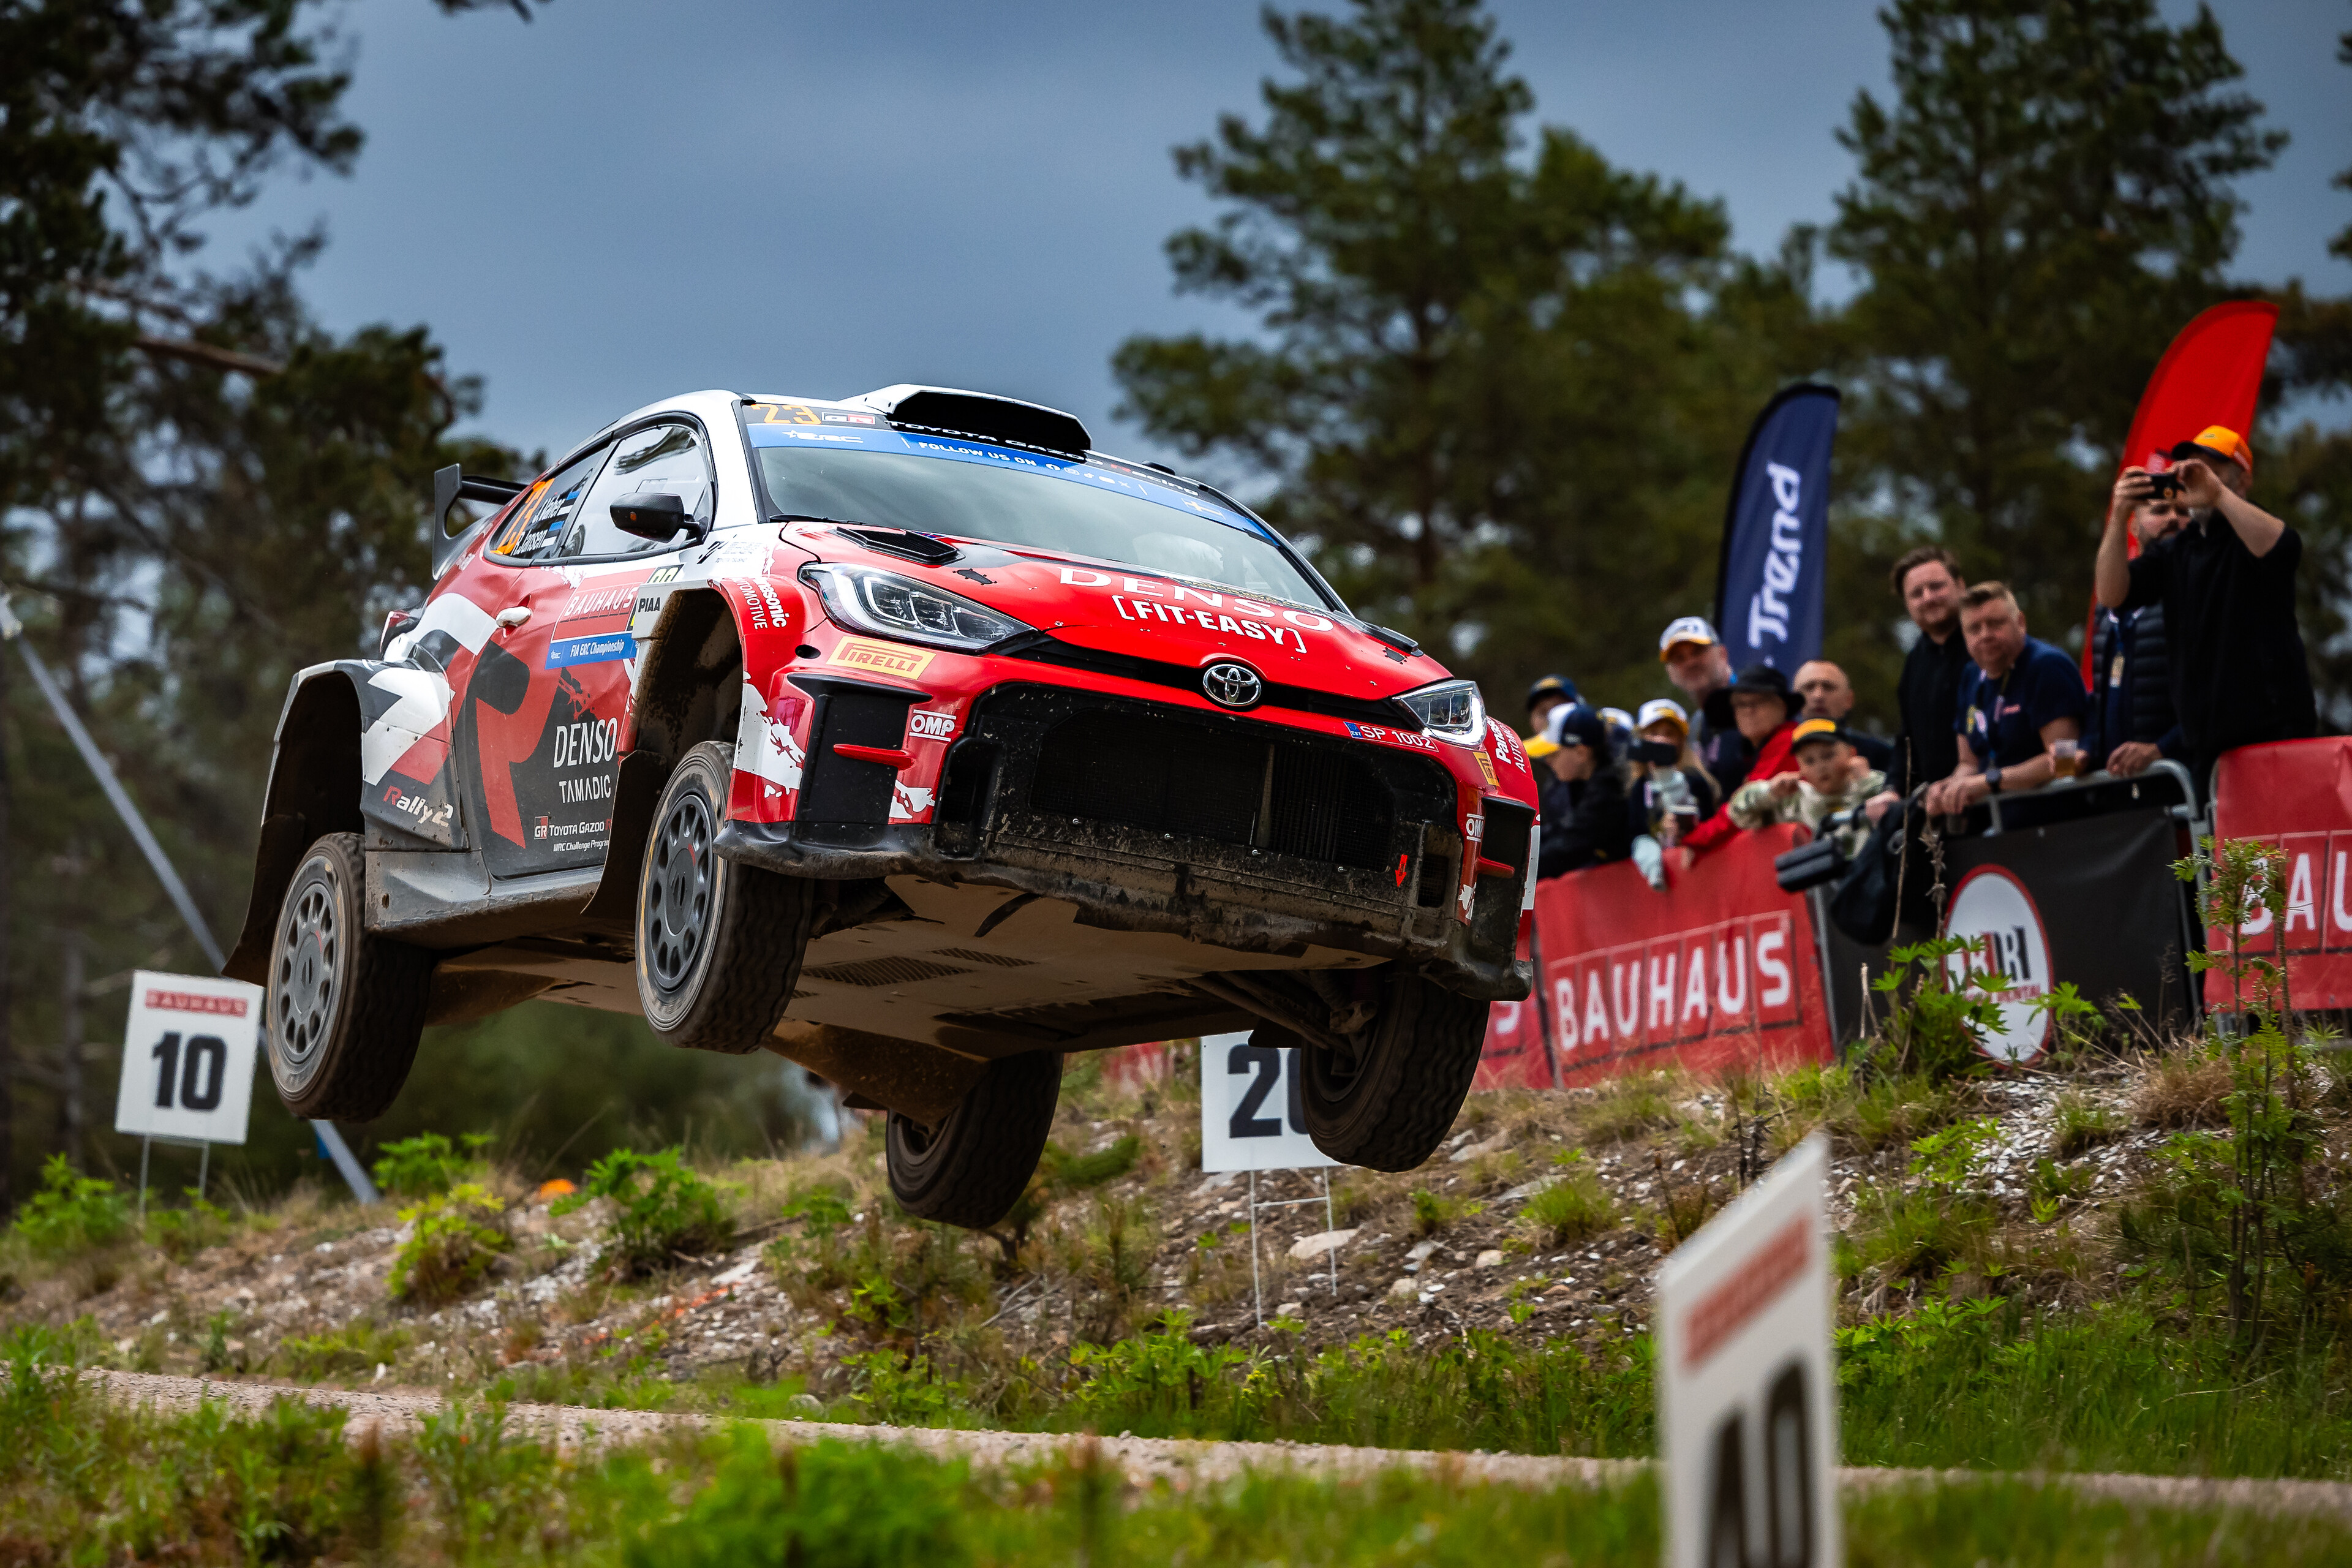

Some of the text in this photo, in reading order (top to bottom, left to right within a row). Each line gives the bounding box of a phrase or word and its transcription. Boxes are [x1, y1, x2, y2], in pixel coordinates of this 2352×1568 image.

[750, 404, 822, 424] 23
[884, 420, 998, 442] TOYOTA
[1005, 440, 1103, 466] GAZOO
[919, 442, 1037, 466] FOLLOW US ON
[1748, 460, 1802, 649] Trend
[564, 586, 639, 617] BAUHAUS
[638, 597, 661, 613] PIAA
[1058, 567, 1334, 632] DENSO
[570, 644, 579, 657] FIA
[579, 642, 591, 656] ERC
[590, 638, 625, 656] Championship
[838, 643, 922, 672] PIRELLI
[911, 714, 956, 736] OMP
[1359, 725, 1435, 749] SP 1002
[553, 717, 618, 768] DENSO
[559, 774, 611, 804] TAMADIC
[535, 825, 547, 838] GR
[549, 824, 578, 837] TOYOTA
[579, 821, 605, 834] GAZOO
[552, 843, 565, 852] WRC
[566, 841, 590, 851] Challenge
[1555, 929, 1792, 1052] BAUHAUS
[151, 1030, 227, 1111] 10
